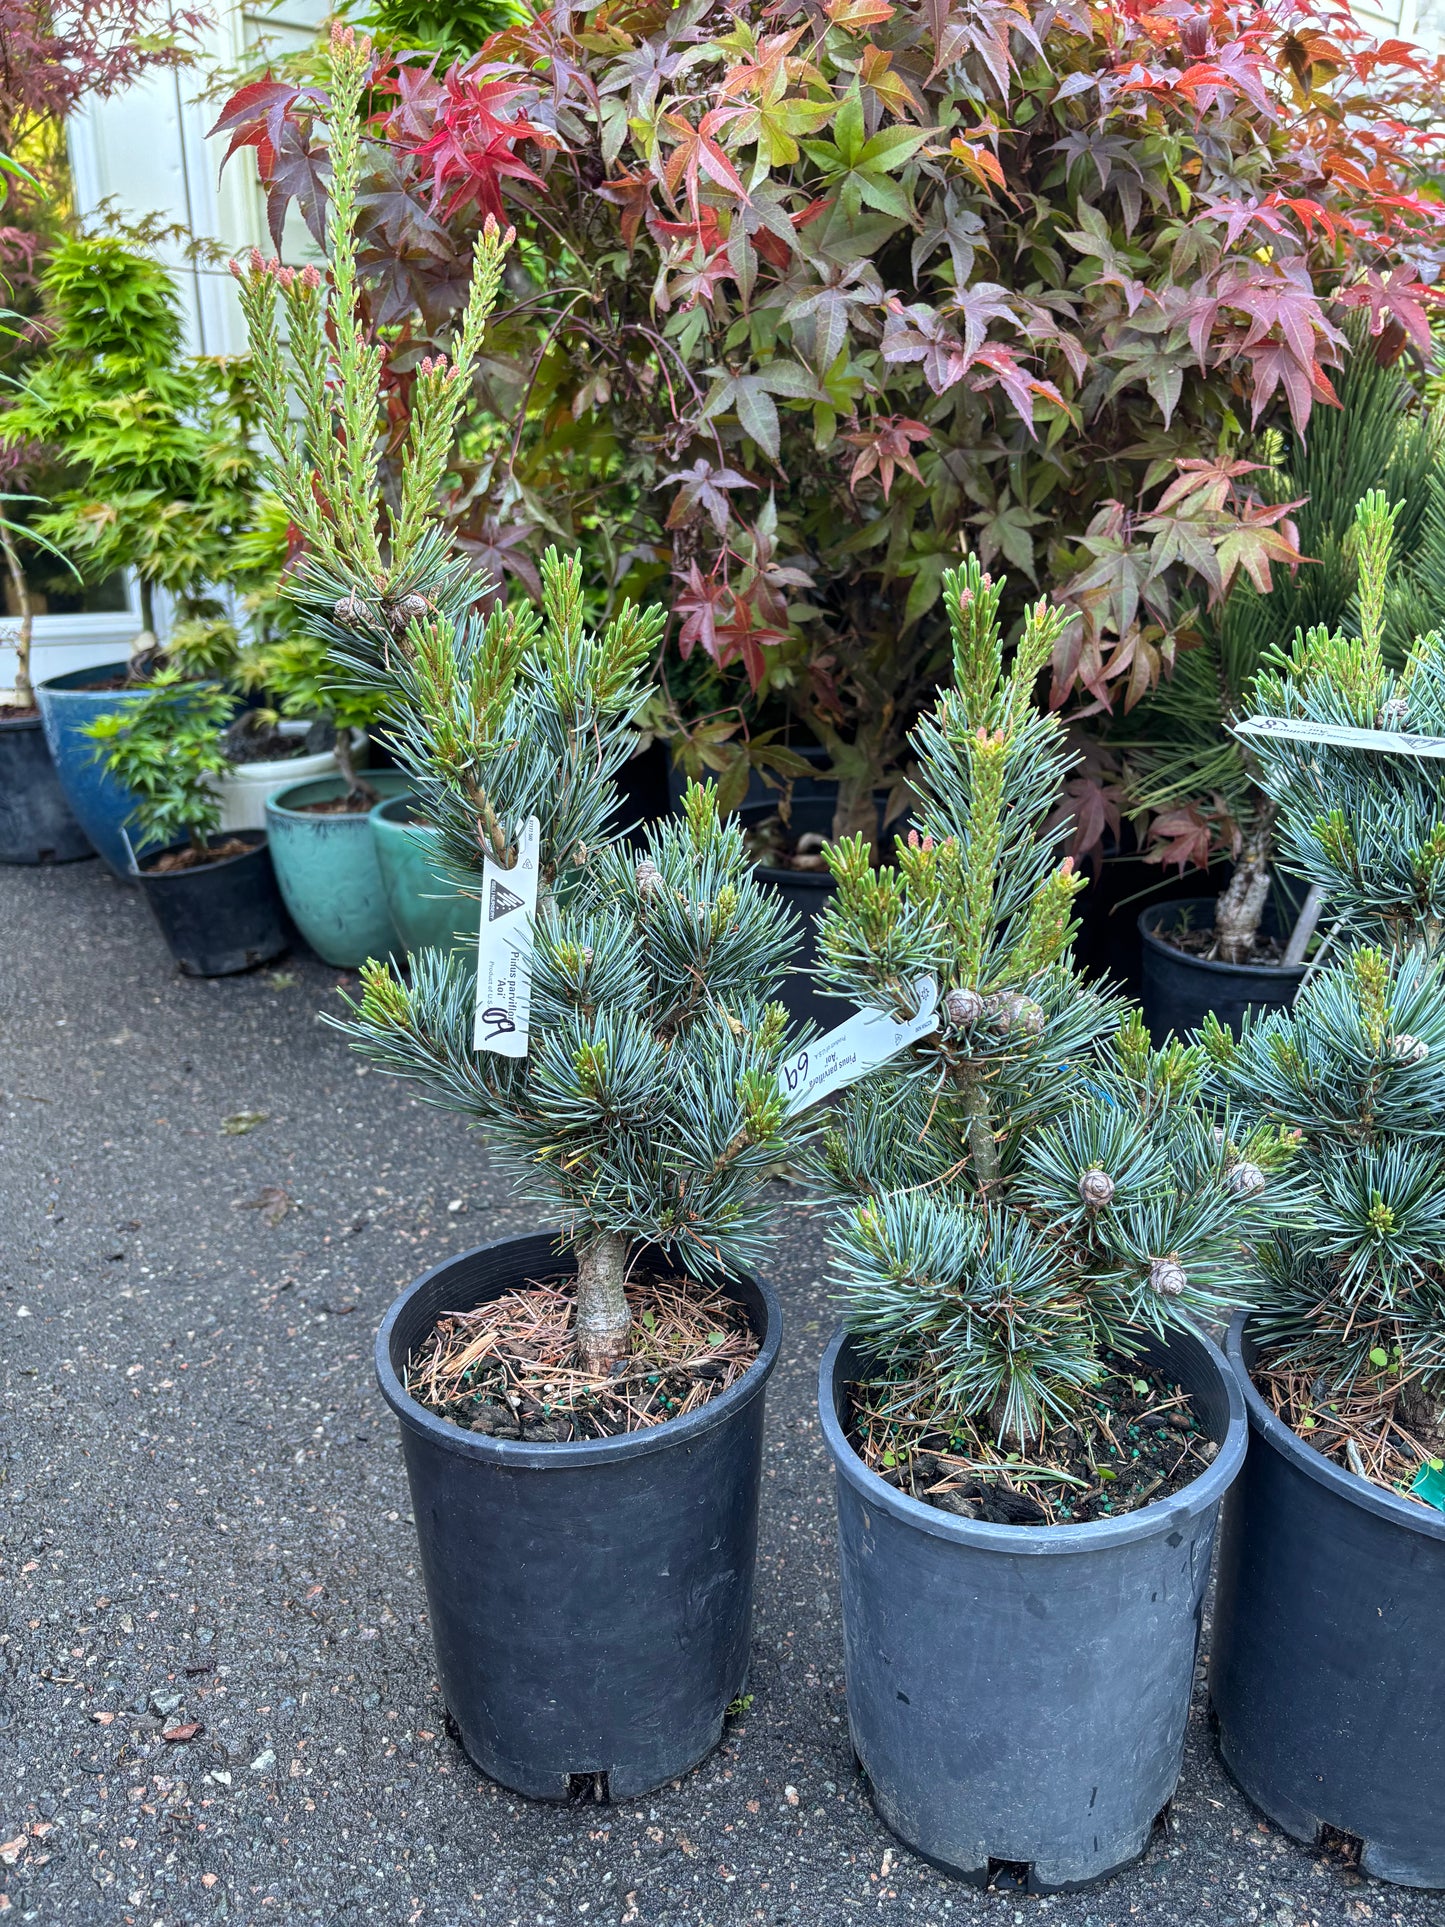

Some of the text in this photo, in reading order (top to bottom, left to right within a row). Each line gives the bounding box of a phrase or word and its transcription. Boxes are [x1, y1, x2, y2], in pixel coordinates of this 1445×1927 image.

[511, 951, 520, 978] Pinus
[784, 1051, 809, 1092] 69
[808, 1052, 857, 1088] Pinus parviflora
